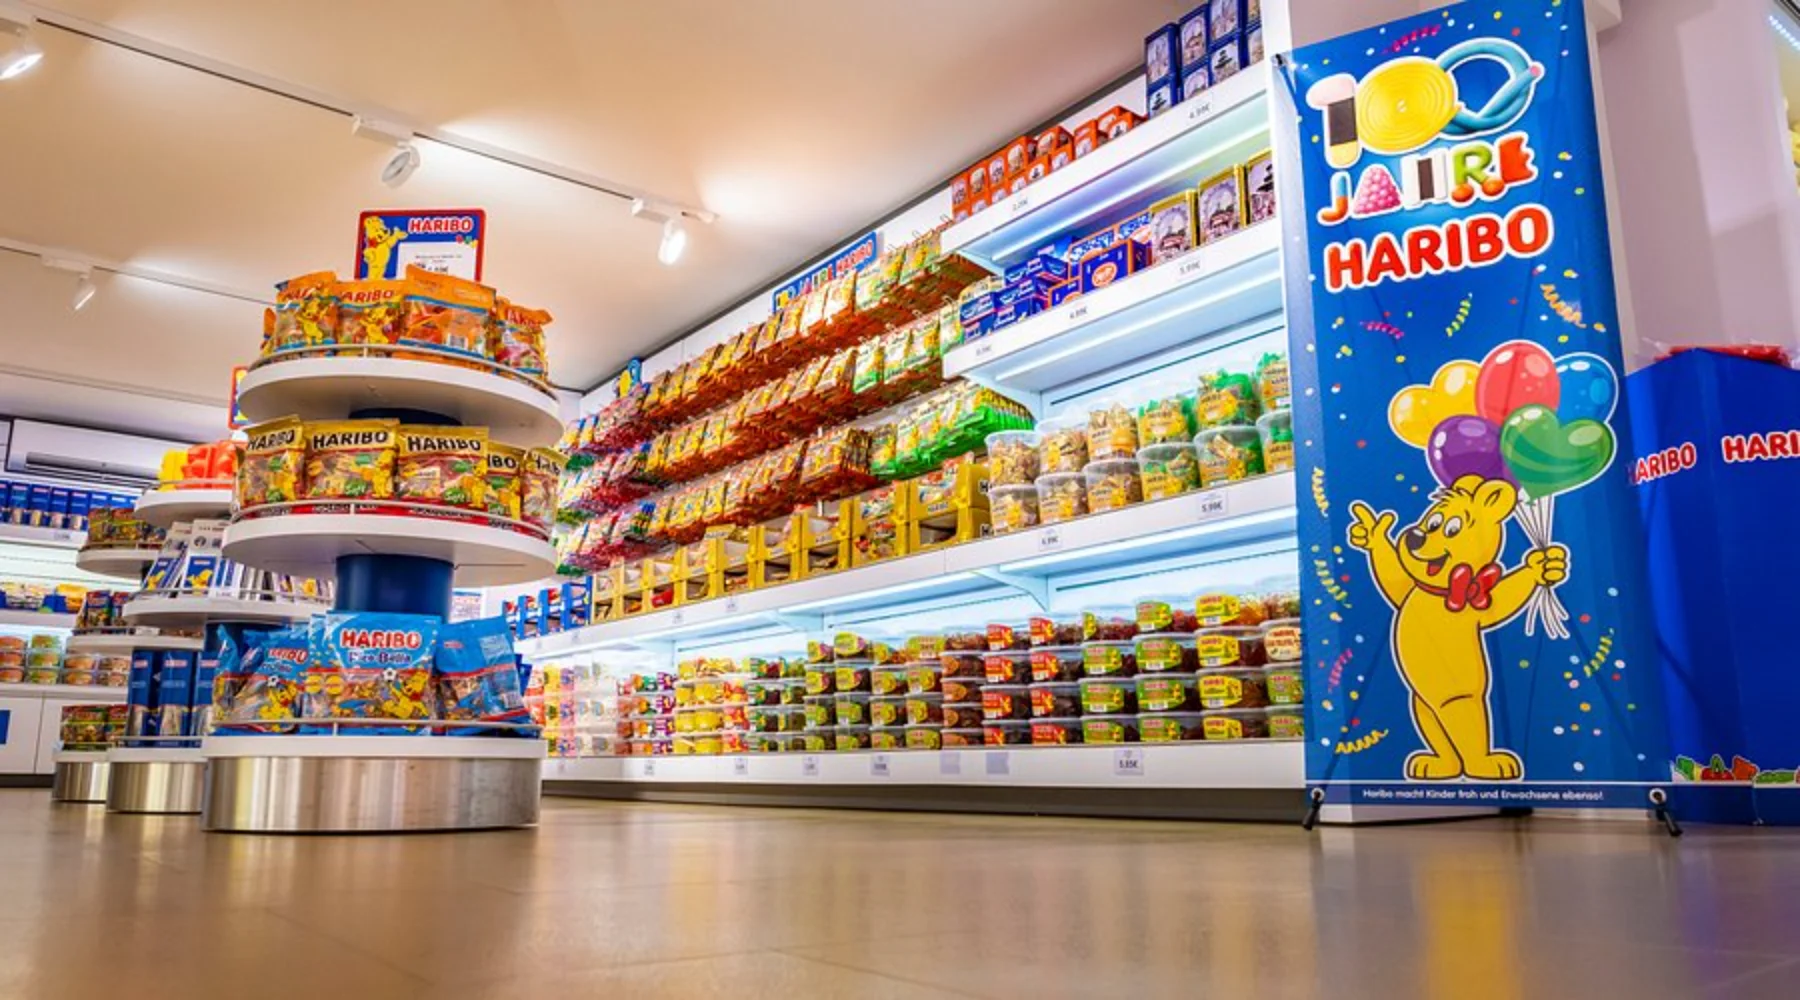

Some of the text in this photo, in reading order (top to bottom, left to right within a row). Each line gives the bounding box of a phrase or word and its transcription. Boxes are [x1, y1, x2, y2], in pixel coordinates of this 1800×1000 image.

[1306, 37, 1544, 168] 100
[1317, 132, 1538, 226] JAHRE
[408, 216, 474, 234] HARIBO
[1325, 205, 1553, 292] HARIBO
[248, 429, 296, 450] HARIBO
[312, 430, 389, 450] HARIBO
[406, 435, 481, 451] HARIBO
[1721, 429, 1800, 463] HARI
[340, 628, 421, 649] HARIBO
[1362, 789, 1393, 799] Haribo
[1395, 789, 1424, 799] macht
[1426, 789, 1457, 799] Kinder
[1480, 790, 1499, 799] und
[1501, 789, 1560, 800] Erwachsene
[1561, 790, 1604, 801] ebenso!
